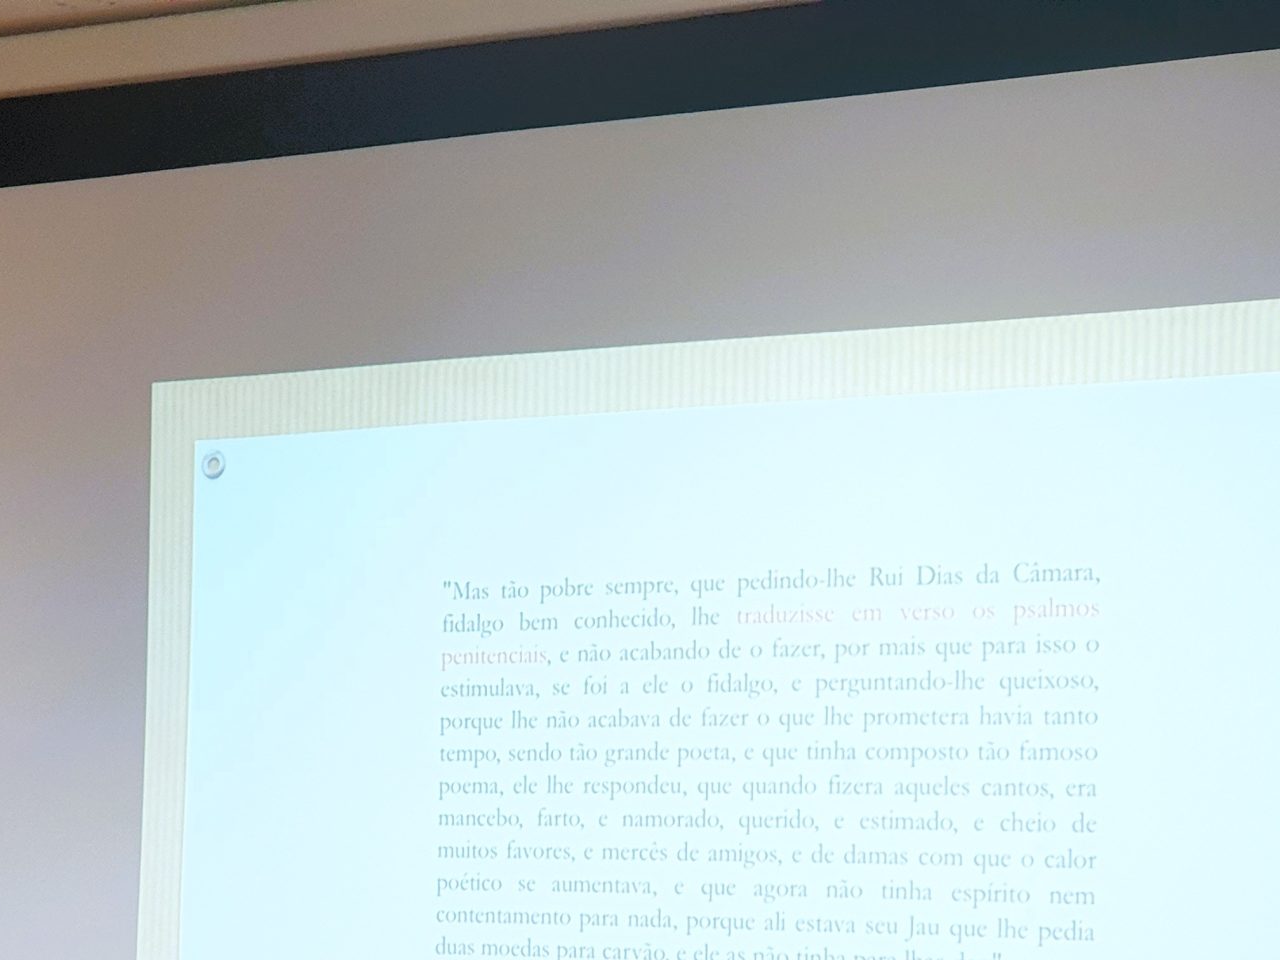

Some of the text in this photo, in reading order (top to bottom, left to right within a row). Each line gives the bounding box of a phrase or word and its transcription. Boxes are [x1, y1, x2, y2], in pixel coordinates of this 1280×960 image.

[442, 561, 1101, 605] "Mas tão pobre sempre, que pedindo-lhe Rui Dias da Câmara,
[442, 596, 1100, 639] fidalgo bem conhecido, lhe traduzisse em verso os psalmos
[441, 632, 1101, 673] penitenciais, e não acabando de o fazer, por mais que para isso o
[440, 668, 1100, 699] estimulava, se foi a ele o fidalgo, e perguntando-lhe queixoso,
[439, 704, 1099, 737] porque lhe não acabava de fazer o que lhe prometera havia tanto
[439, 739, 1099, 769] tempo, sendo tão grande poeta, e que tinha composto tão famoso
[438, 773, 1097, 803] poema, ele lhe respondeu, que quando fizera aqueles cantos, era
[438, 806, 1097, 836] mancebo, farto, e namorado, querido, e estimado, e cheio de
[437, 839, 1097, 875] muitos favores, e mercês de amigos, e de damas com que o calor
[436, 872, 1096, 910] poético se aumentava, e que agora não tinha espírito nem
[435, 907, 1095, 948] contentamento para nada, porque ali estava seu Jau que lhe pedia
[434, 935, 476, 956] duas
[481, 937, 550, 958] moedas
